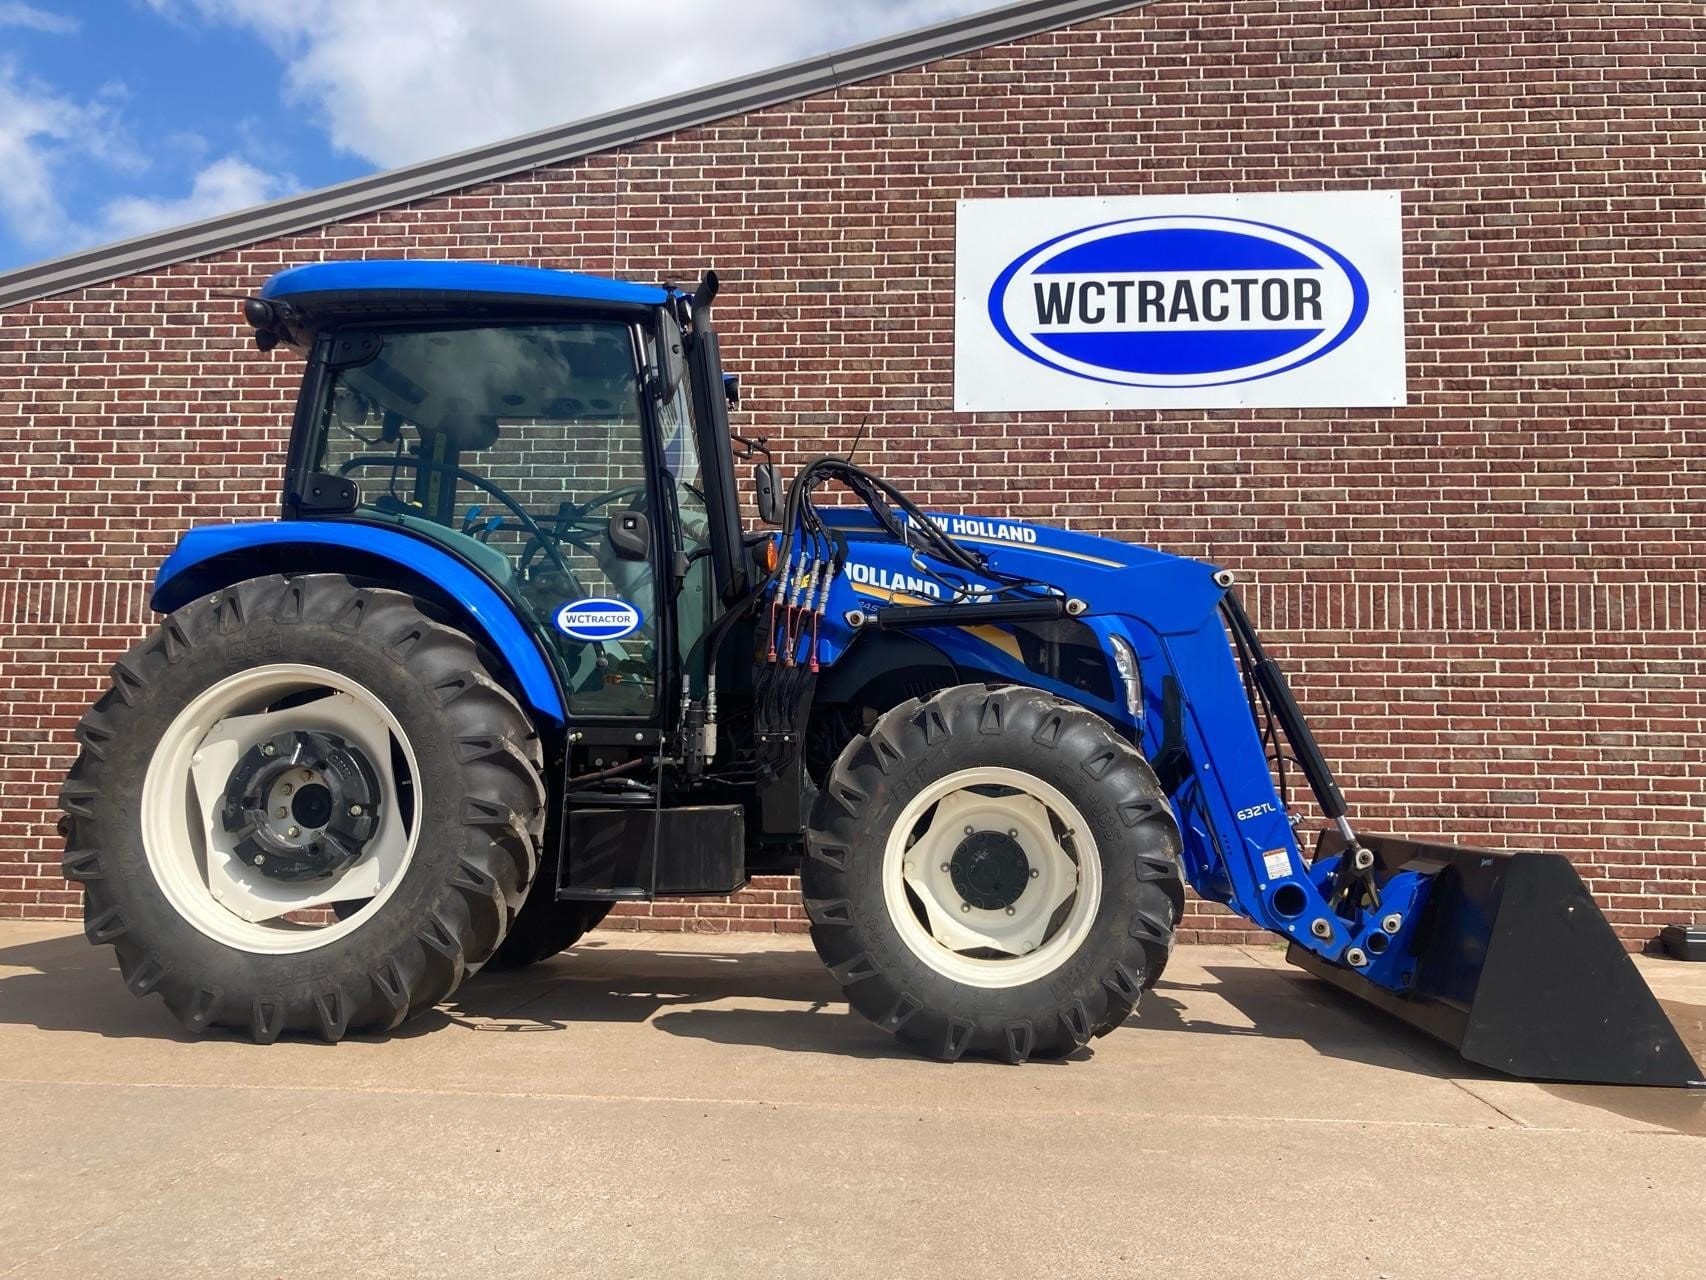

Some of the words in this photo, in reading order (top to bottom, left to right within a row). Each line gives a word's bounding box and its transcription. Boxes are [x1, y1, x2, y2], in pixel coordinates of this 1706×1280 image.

[1034, 278, 1322, 325] WCTRACTOR
[908, 515, 949, 532] NW
[953, 519, 1037, 544] HOLLAND
[1237, 802, 1277, 821] 632TL
